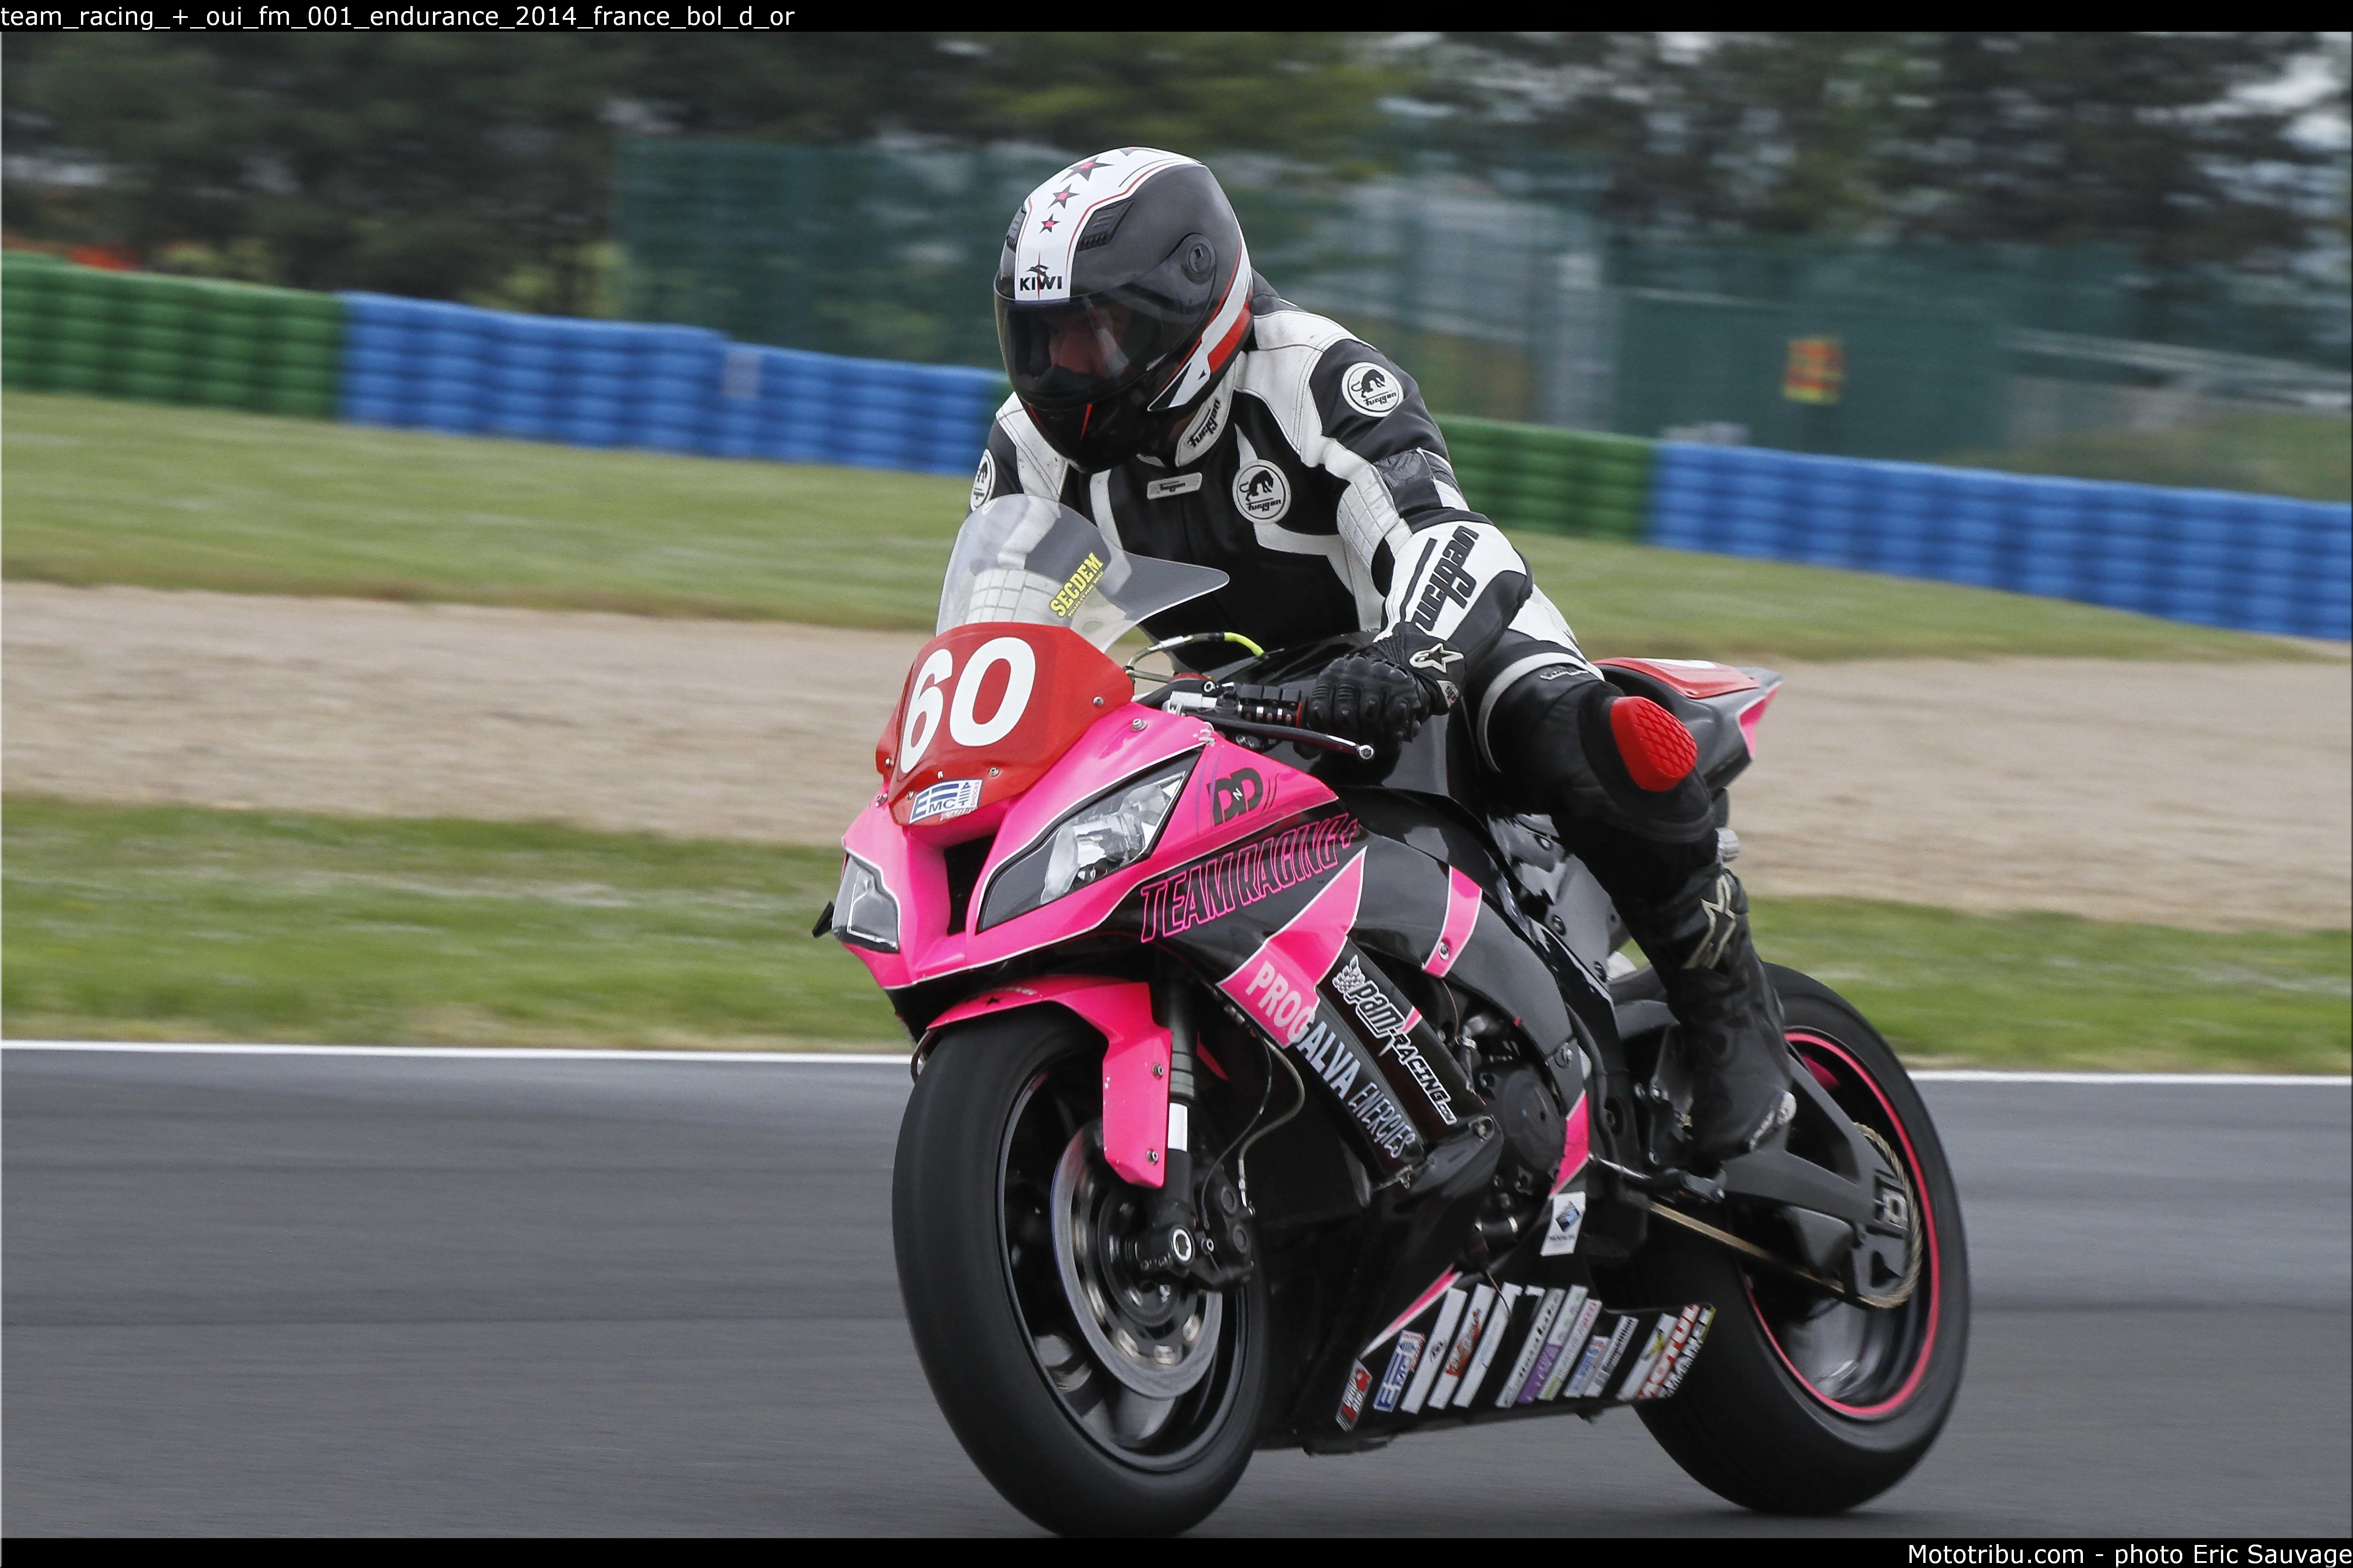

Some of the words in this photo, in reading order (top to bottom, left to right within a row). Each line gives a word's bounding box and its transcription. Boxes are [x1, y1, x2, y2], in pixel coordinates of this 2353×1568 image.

[1020, 275, 1062, 291] KIWI
[1187, 398, 1221, 448] Furygan
[1364, 389, 1397, 407] Furygan
[1246, 497, 1281, 512] Furygan
[1050, 552, 1103, 617] SECDEM
[900, 637, 1036, 773] 60
[1141, 852, 1237, 944] TEAM
[1246, 961, 1362, 1100] PROGALVA
[1348, 1081, 1417, 1159] ENERGIES
